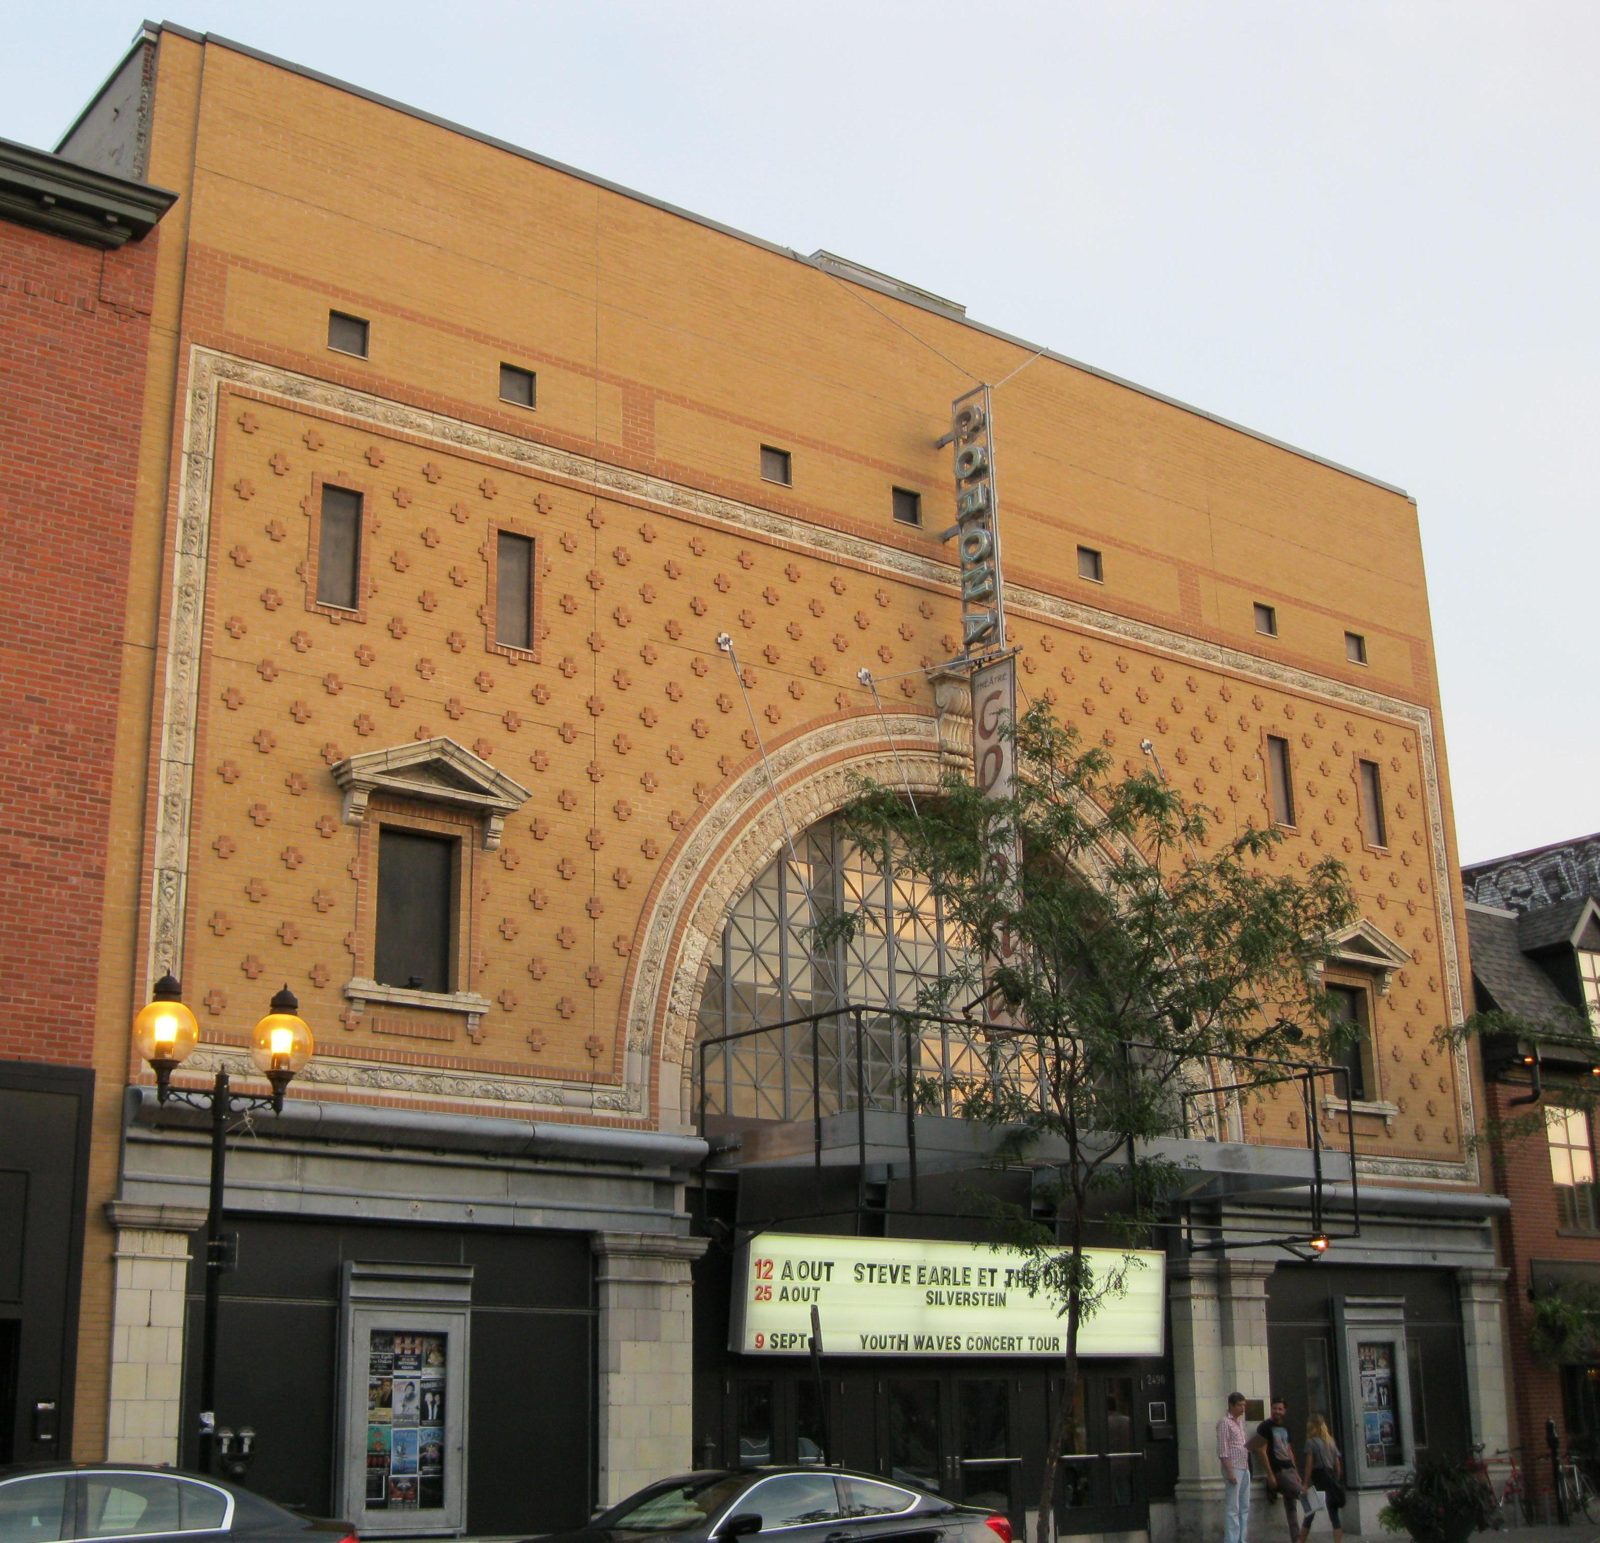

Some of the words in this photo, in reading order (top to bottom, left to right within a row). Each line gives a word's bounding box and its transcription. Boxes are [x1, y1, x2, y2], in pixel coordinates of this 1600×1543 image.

[954, 404, 996, 644] CORONA
[754, 1258, 774, 1280] 12
[780, 1259, 835, 1282] AOUT
[854, 1262, 912, 1284] STEVE
[917, 1264, 972, 1287] EARLE
[977, 1267, 998, 1288] ET
[1004, 1268, 1038, 1289] THE
[754, 1285, 773, 1301] 25
[779, 1286, 821, 1302] AOUT
[925, 1290, 1007, 1307] SILVERSTEIN
[755, 1332, 765, 1349] 9
[769, 1332, 807, 1350] SEPT
[859, 1333, 909, 1351] YOUTH
[913, 1335, 961, 1351] WAVES
[966, 1336, 1024, 1351] CONCERT
[1028, 1336, 1060, 1351] TOUR
